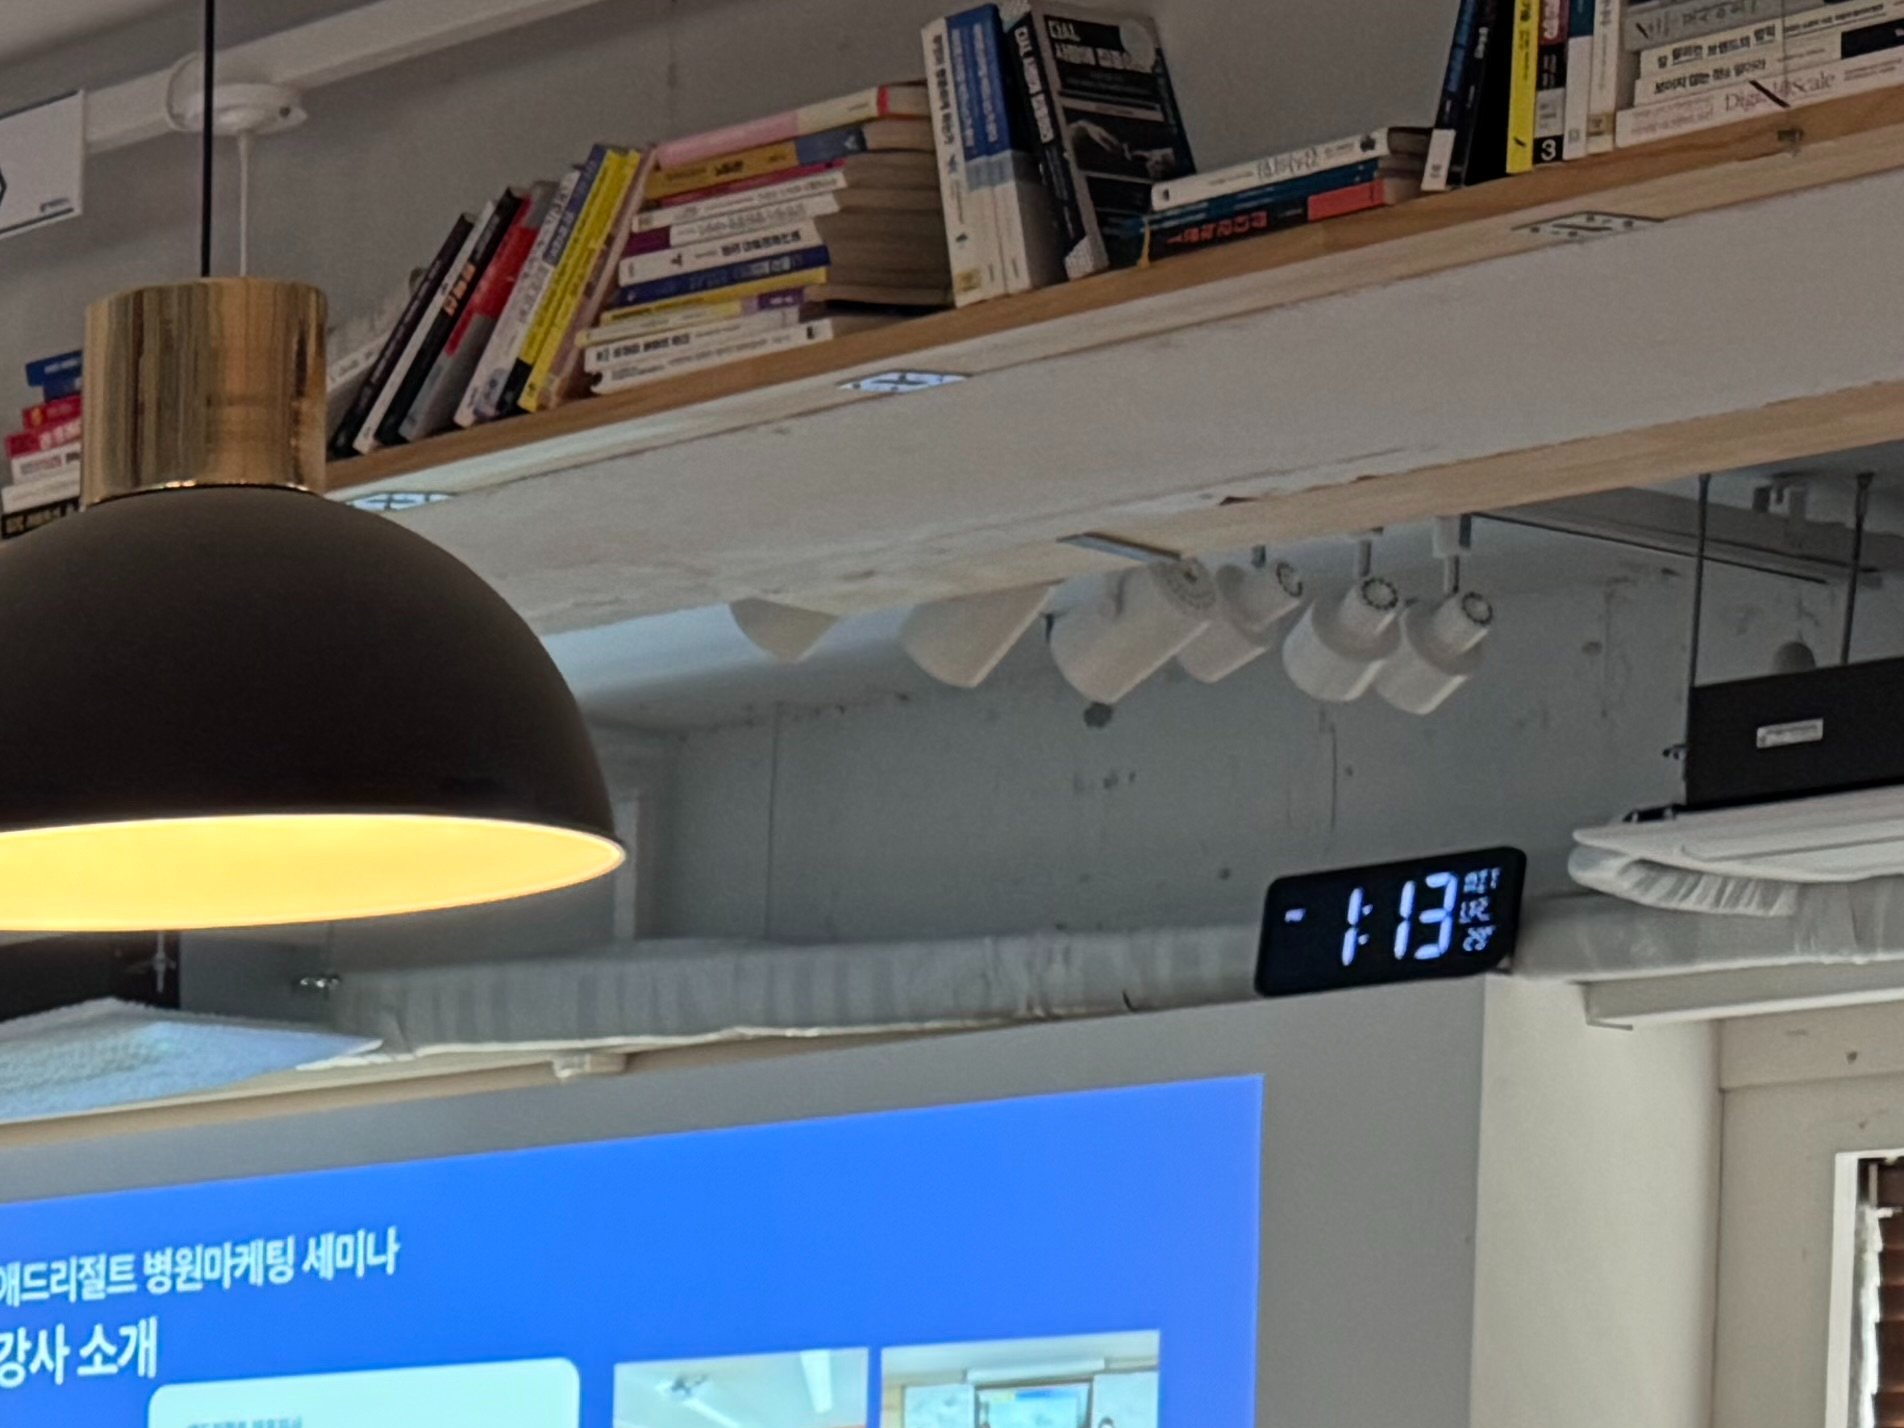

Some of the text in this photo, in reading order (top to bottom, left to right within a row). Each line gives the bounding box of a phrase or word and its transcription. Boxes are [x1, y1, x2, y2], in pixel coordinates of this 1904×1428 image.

[1541, 138, 1557, 161] 3
[143, 1236, 296, 1295] 병원마케팅
[301, 1226, 401, 1281] 세미나
[76, 1315, 159, 1380] 소개
